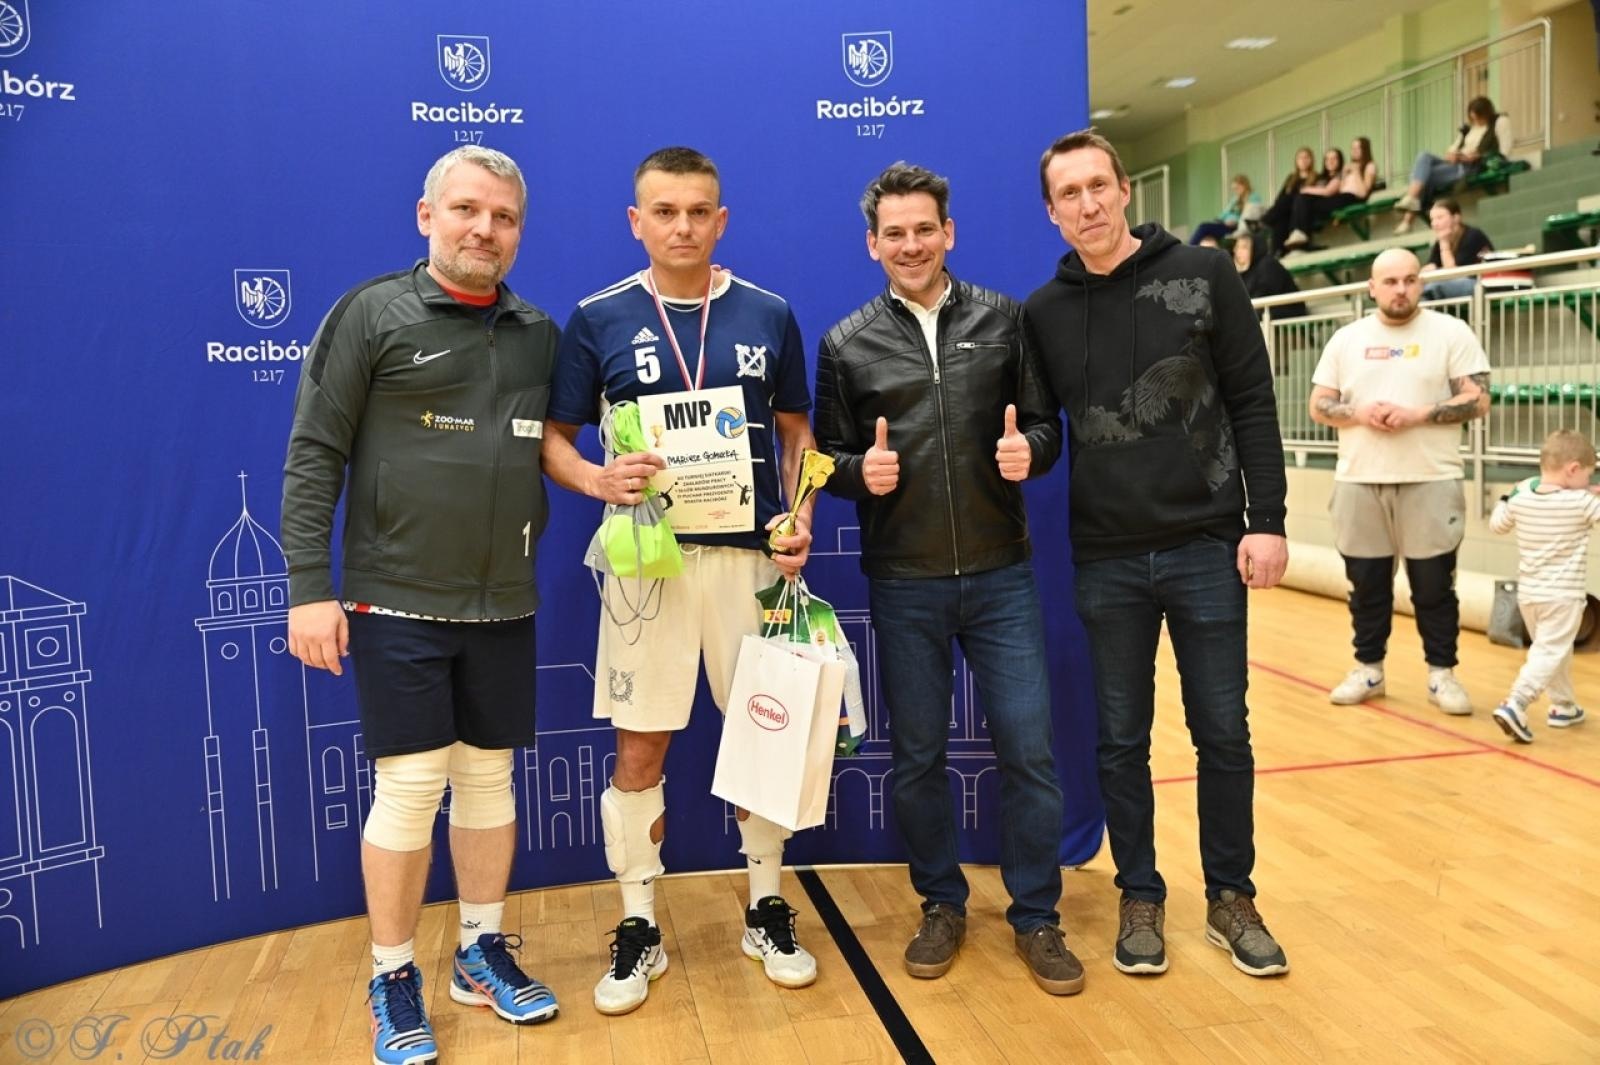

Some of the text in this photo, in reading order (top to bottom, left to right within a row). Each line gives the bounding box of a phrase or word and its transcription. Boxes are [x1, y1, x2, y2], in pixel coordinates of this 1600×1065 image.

[0, 70, 76, 101] bórz
[411, 101, 524, 123] Racibórz
[816, 95, 925, 119] Racibórz
[453, 130, 484, 146] 1217
[856, 124, 885, 140] 1217
[206, 339, 311, 362] Racibór
[252, 369, 285, 385] 1217
[634, 345, 661, 385] 5
[663, 400, 712, 431] MVP
[522, 520, 531, 557] 1
[750, 700, 786, 725] Henkel
